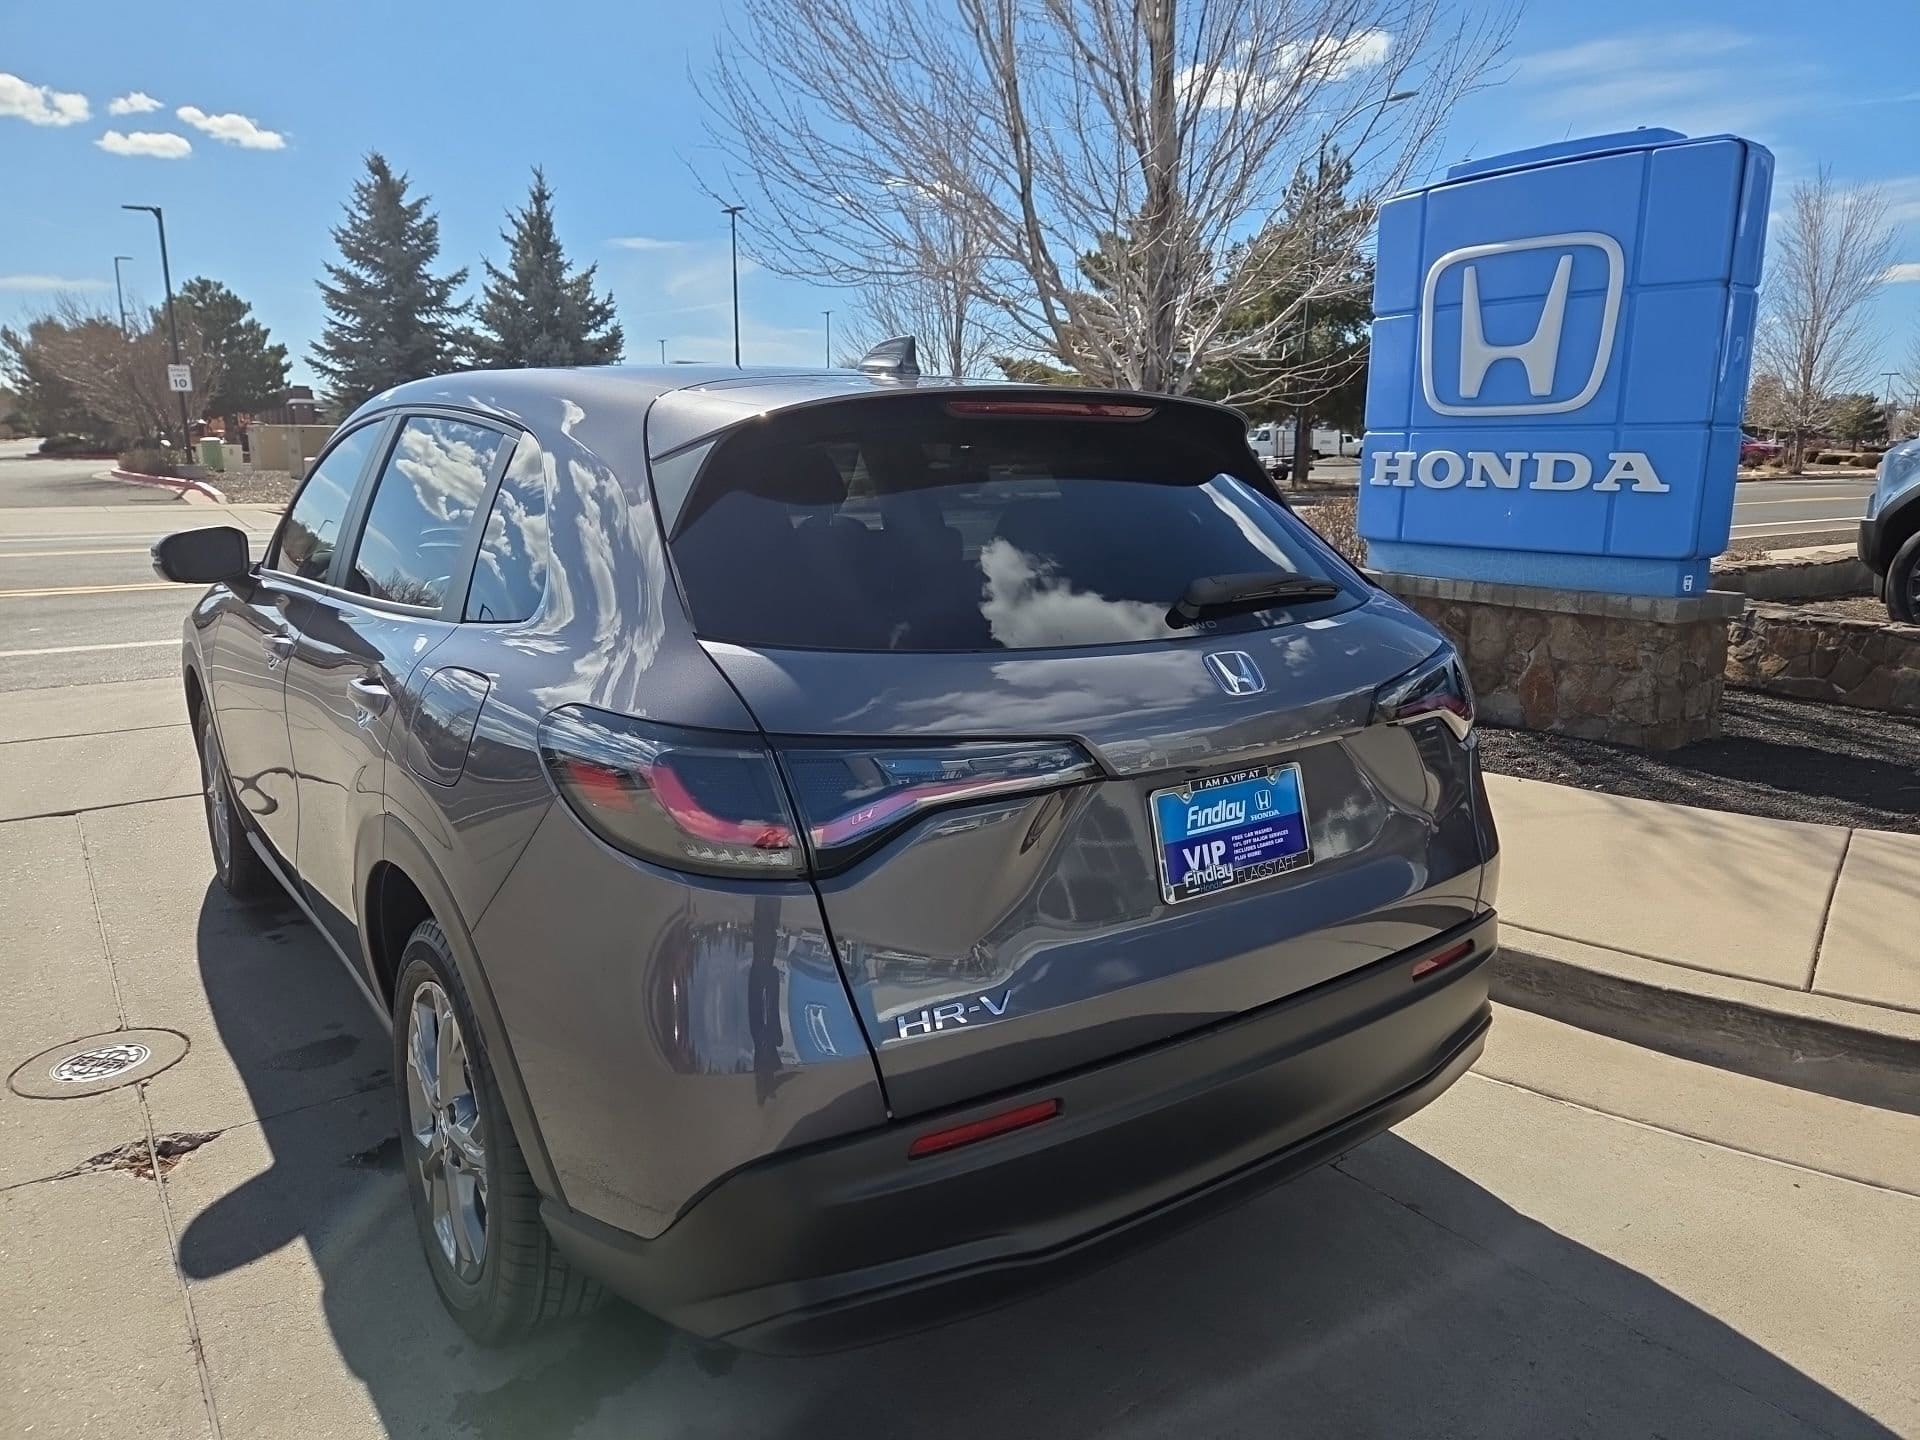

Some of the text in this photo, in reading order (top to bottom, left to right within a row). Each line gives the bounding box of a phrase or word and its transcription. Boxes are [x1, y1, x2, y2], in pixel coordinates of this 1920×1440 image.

[174, 378, 188, 388] 10
[1370, 450, 1670, 493] HONDA
[1199, 769, 1260, 789] I AM A VIP AT
[1187, 799, 1280, 836] Findlay HONDA
[1182, 840, 1226, 871] VIP
[1184, 854, 1297, 888] Findlay FLAGSTAFF
[897, 990, 1011, 1038] HR-V
